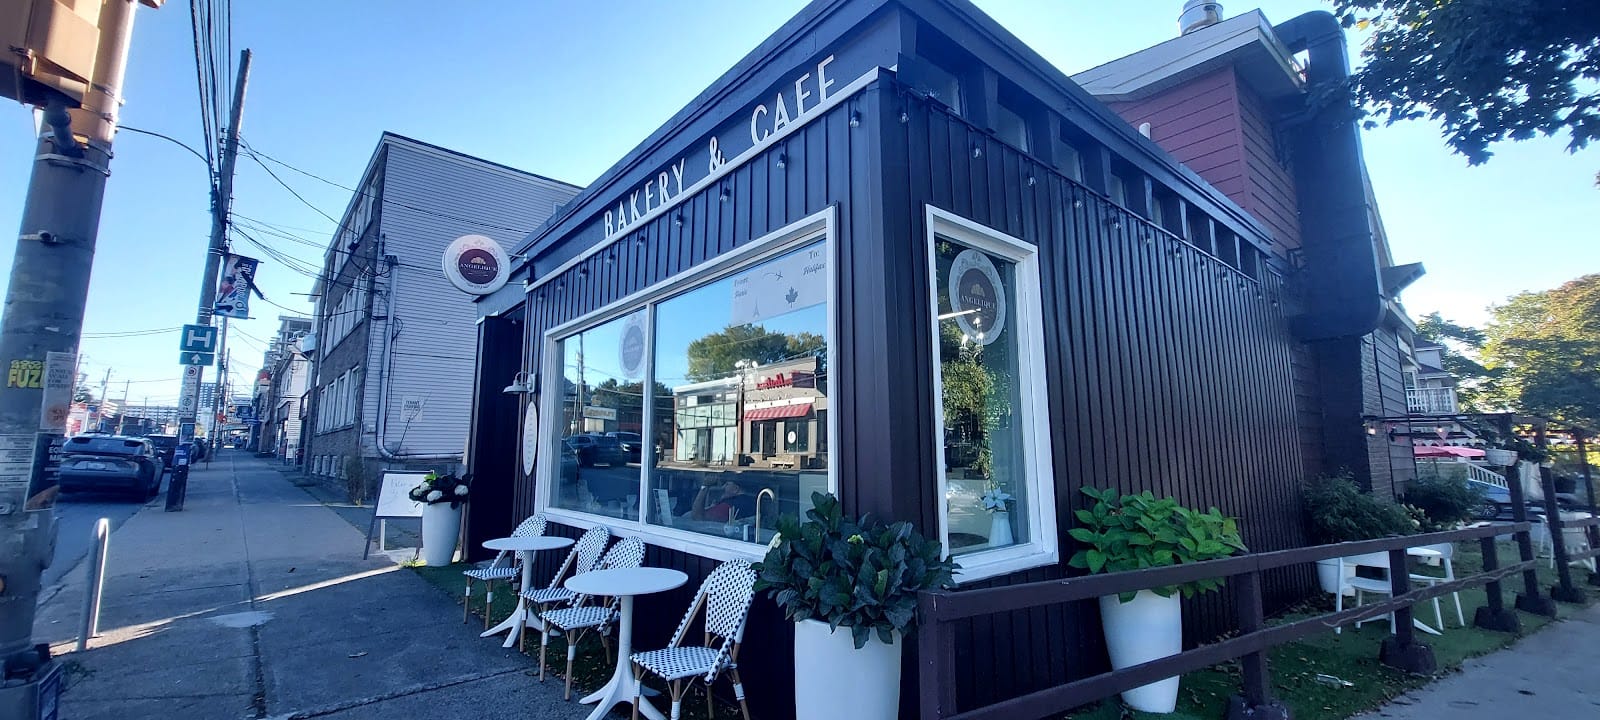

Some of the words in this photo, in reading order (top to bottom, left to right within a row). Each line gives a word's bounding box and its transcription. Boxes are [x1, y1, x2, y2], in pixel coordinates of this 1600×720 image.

[604, 157, 685, 239] BAKERY
[708, 136, 726, 176] &
[186, 329, 212, 348] H
[7, 369, 46, 388] FUZ
